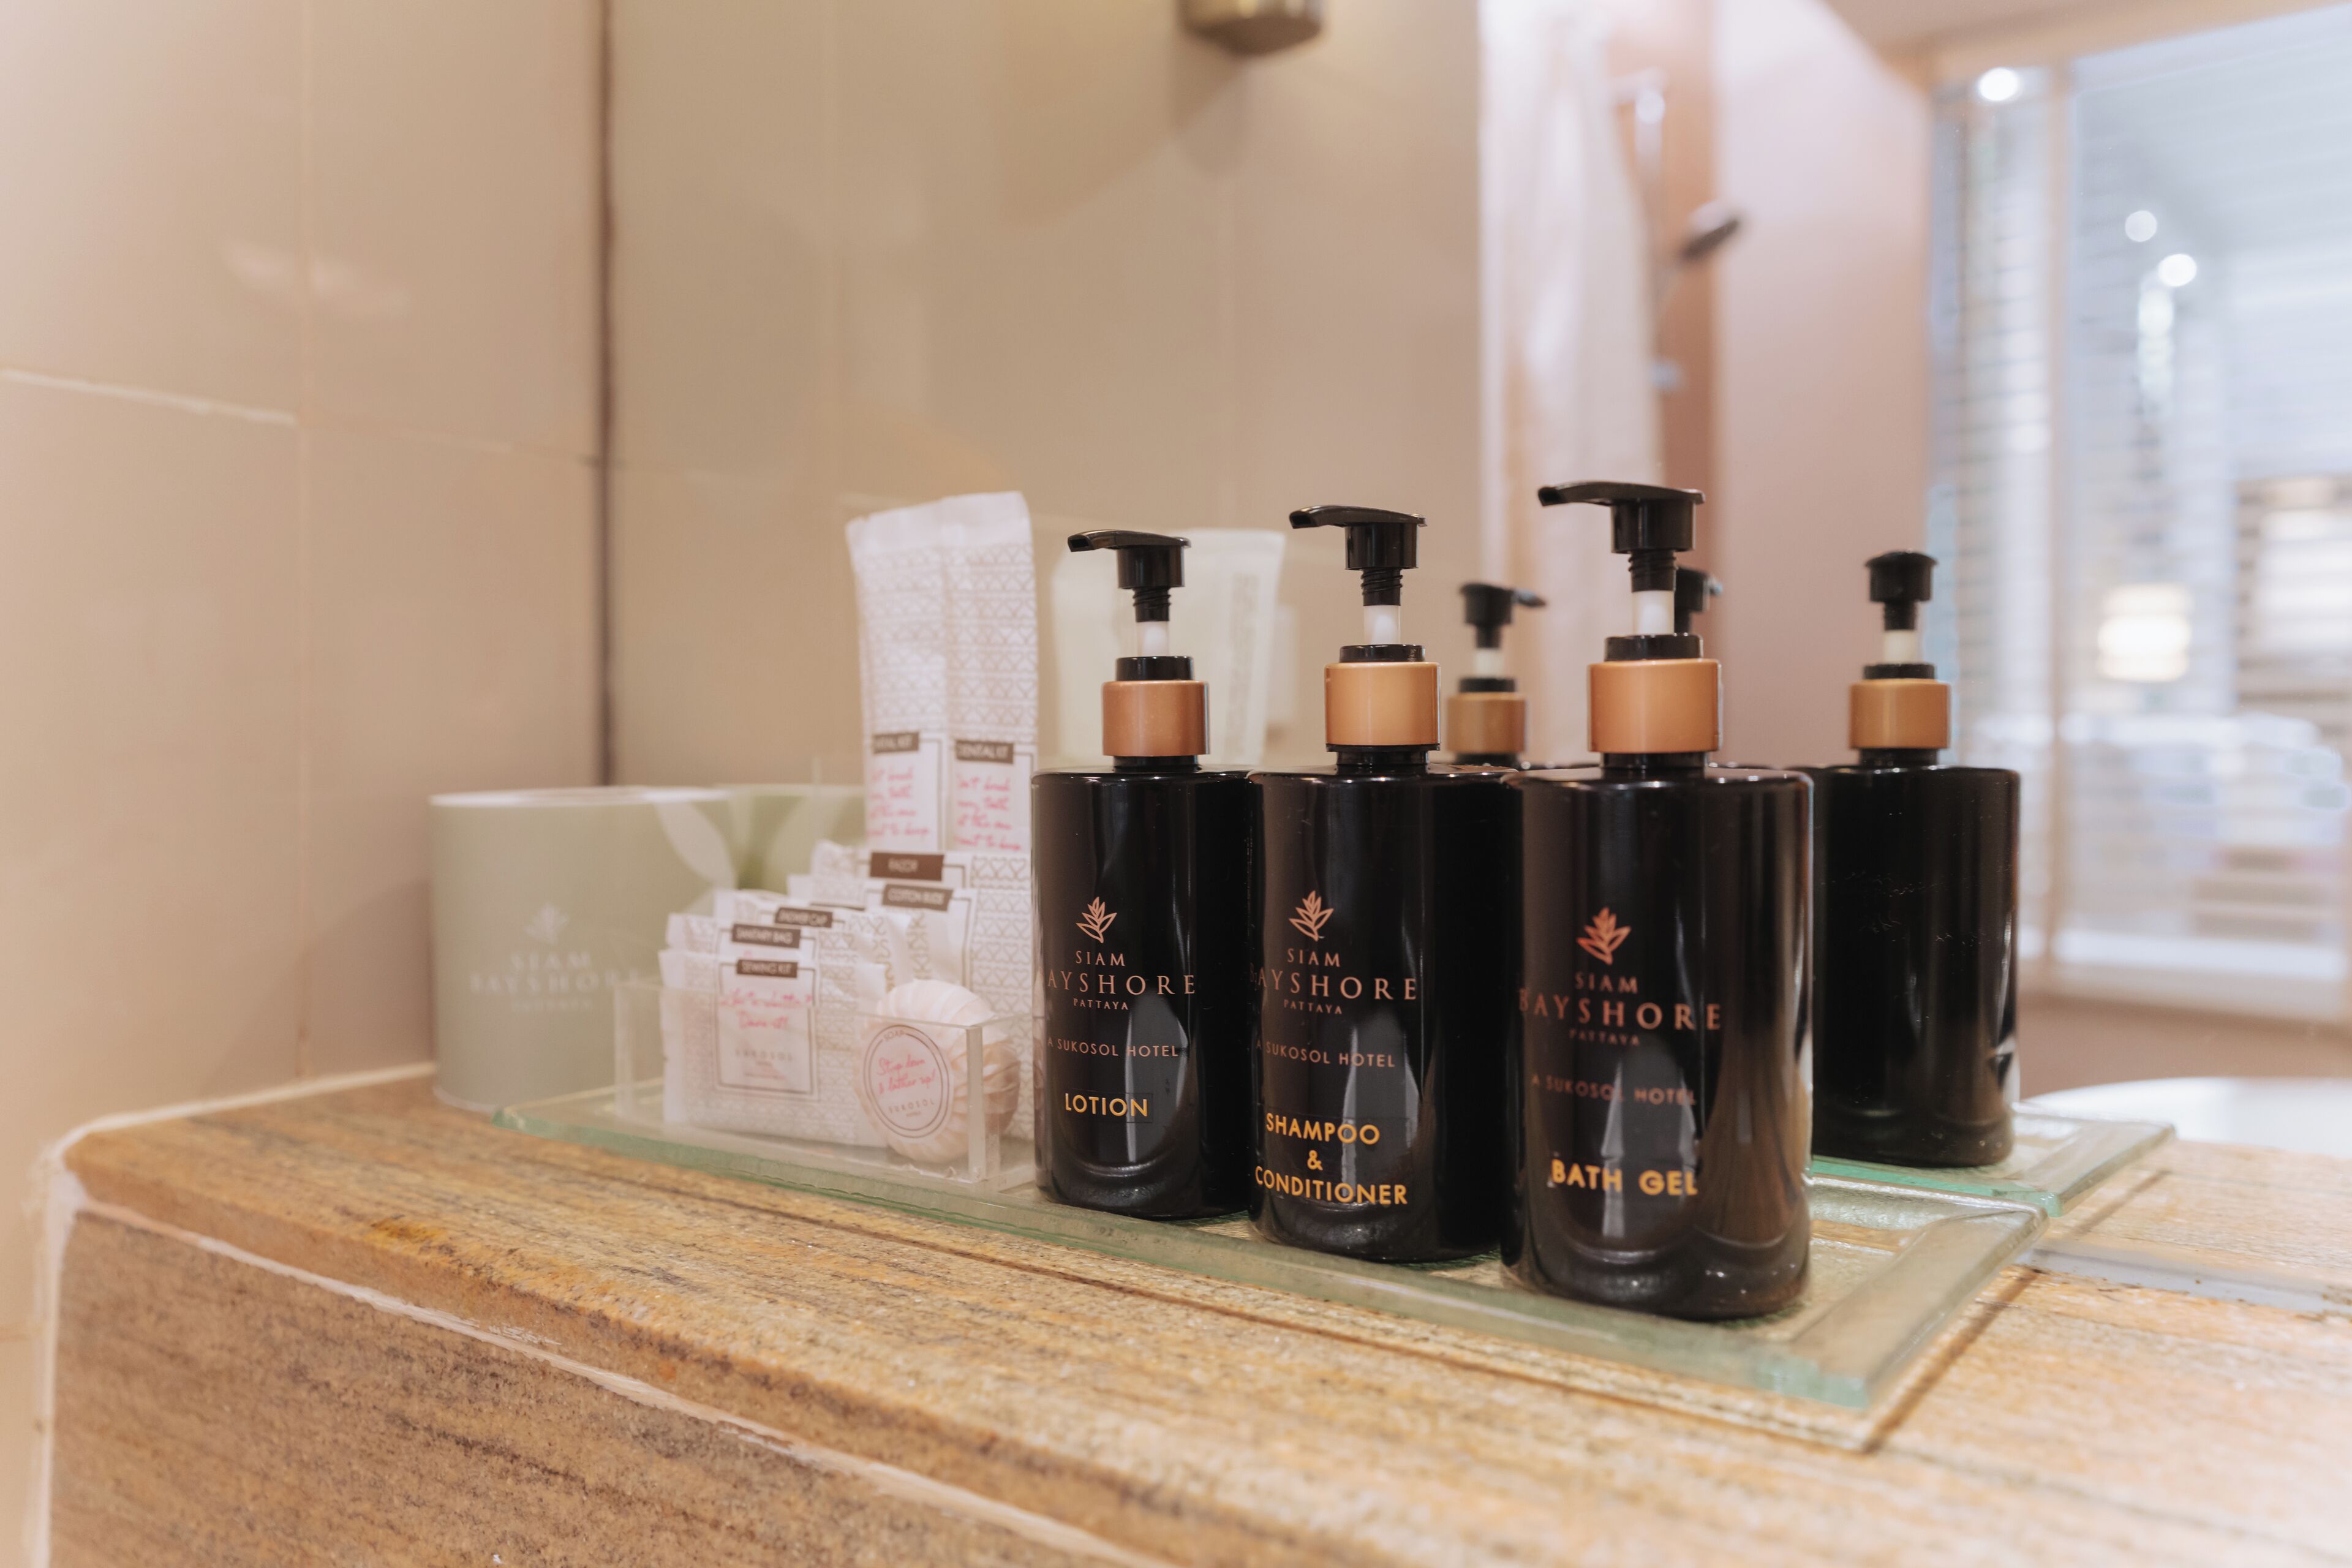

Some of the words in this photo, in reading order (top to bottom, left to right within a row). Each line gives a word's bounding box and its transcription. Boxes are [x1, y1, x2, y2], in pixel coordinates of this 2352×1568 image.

[773, 930, 793, 944] BAG
[742, 960, 778, 974] SEWING
[778, 963, 792, 974] KIT
[1076, 951, 1125, 966] SIAM
[1287, 948, 1341, 968] SIAM
[1046, 968, 1196, 996] AYSHORE
[1575, 972, 1638, 994] SIAM
[1073, 998, 1129, 1010] PATTAYA
[1283, 999, 1343, 1015] PATTAYA
[1519, 987, 1722, 1031] BAYSHORE
[883, 1029, 905, 1042] SOAP
[1047, 1039, 1054, 1047] A
[1057, 1038, 1119, 1057] SUKOSOL
[1128, 1045, 1178, 1057] HOTEL
[1256, 1039, 1262, 1050] A
[1265, 1041, 1331, 1065] SUKOSOL
[1340, 1053, 1396, 1068] HOTEL
[905, 1054, 925, 1068] down
[1065, 1092, 1148, 1117] LOTION
[1634, 1087, 1696, 1106] HOTEL
[1266, 1112, 1381, 1145] SHAMPOO
[1307, 1150, 1323, 1170] &
[1255, 1166, 1408, 1205] CONDITIONER
[1551, 1159, 1623, 1193] BATH
[1639, 1169, 1698, 1196] GEL
